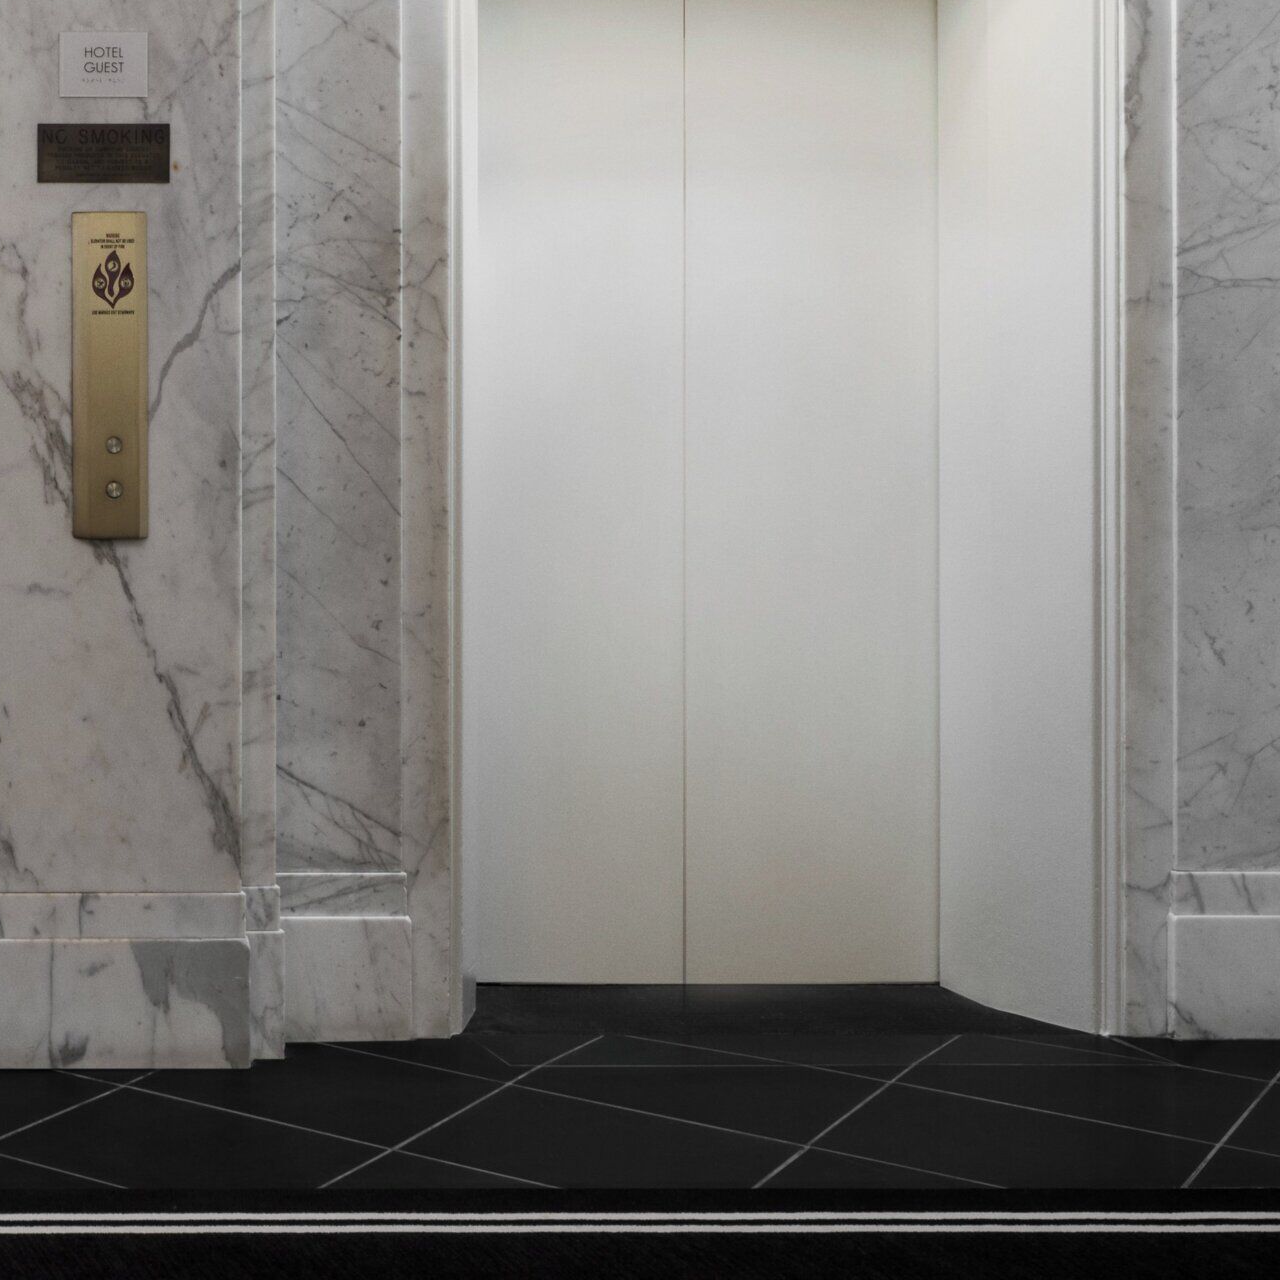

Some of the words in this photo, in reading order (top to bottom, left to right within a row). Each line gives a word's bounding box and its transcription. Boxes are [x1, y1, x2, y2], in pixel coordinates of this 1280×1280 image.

[84, 46, 124, 58] HOTEL
[83, 61, 125, 73] GUEST
[78, 128, 165, 144] SMOKING
